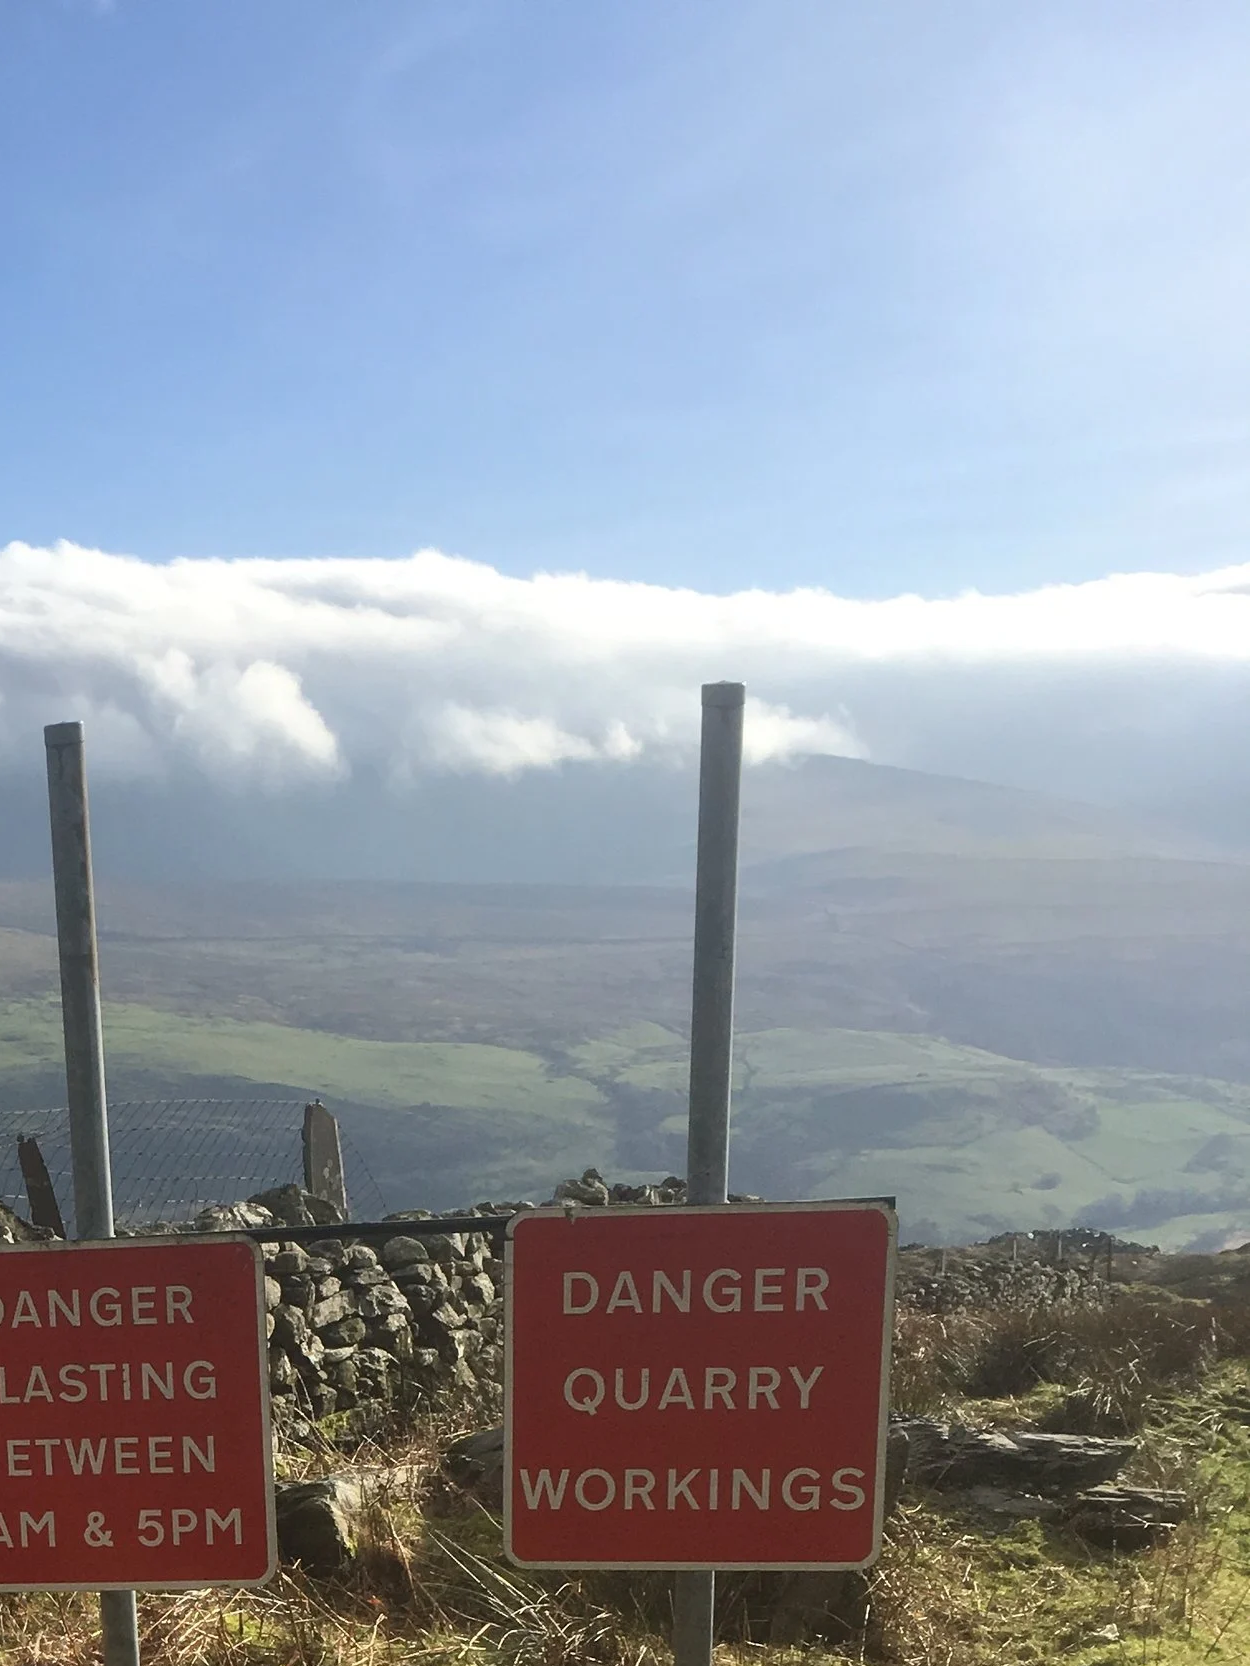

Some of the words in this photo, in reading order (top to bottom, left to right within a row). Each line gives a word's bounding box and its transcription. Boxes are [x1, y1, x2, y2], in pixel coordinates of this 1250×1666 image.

[562, 1267, 830, 1315] DANGER
[563, 1366, 824, 1415] QUARRY
[520, 1467, 866, 1511] WORKINGS
[84, 1511, 114, 1547] &
[137, 1507, 243, 1547] 5PM
